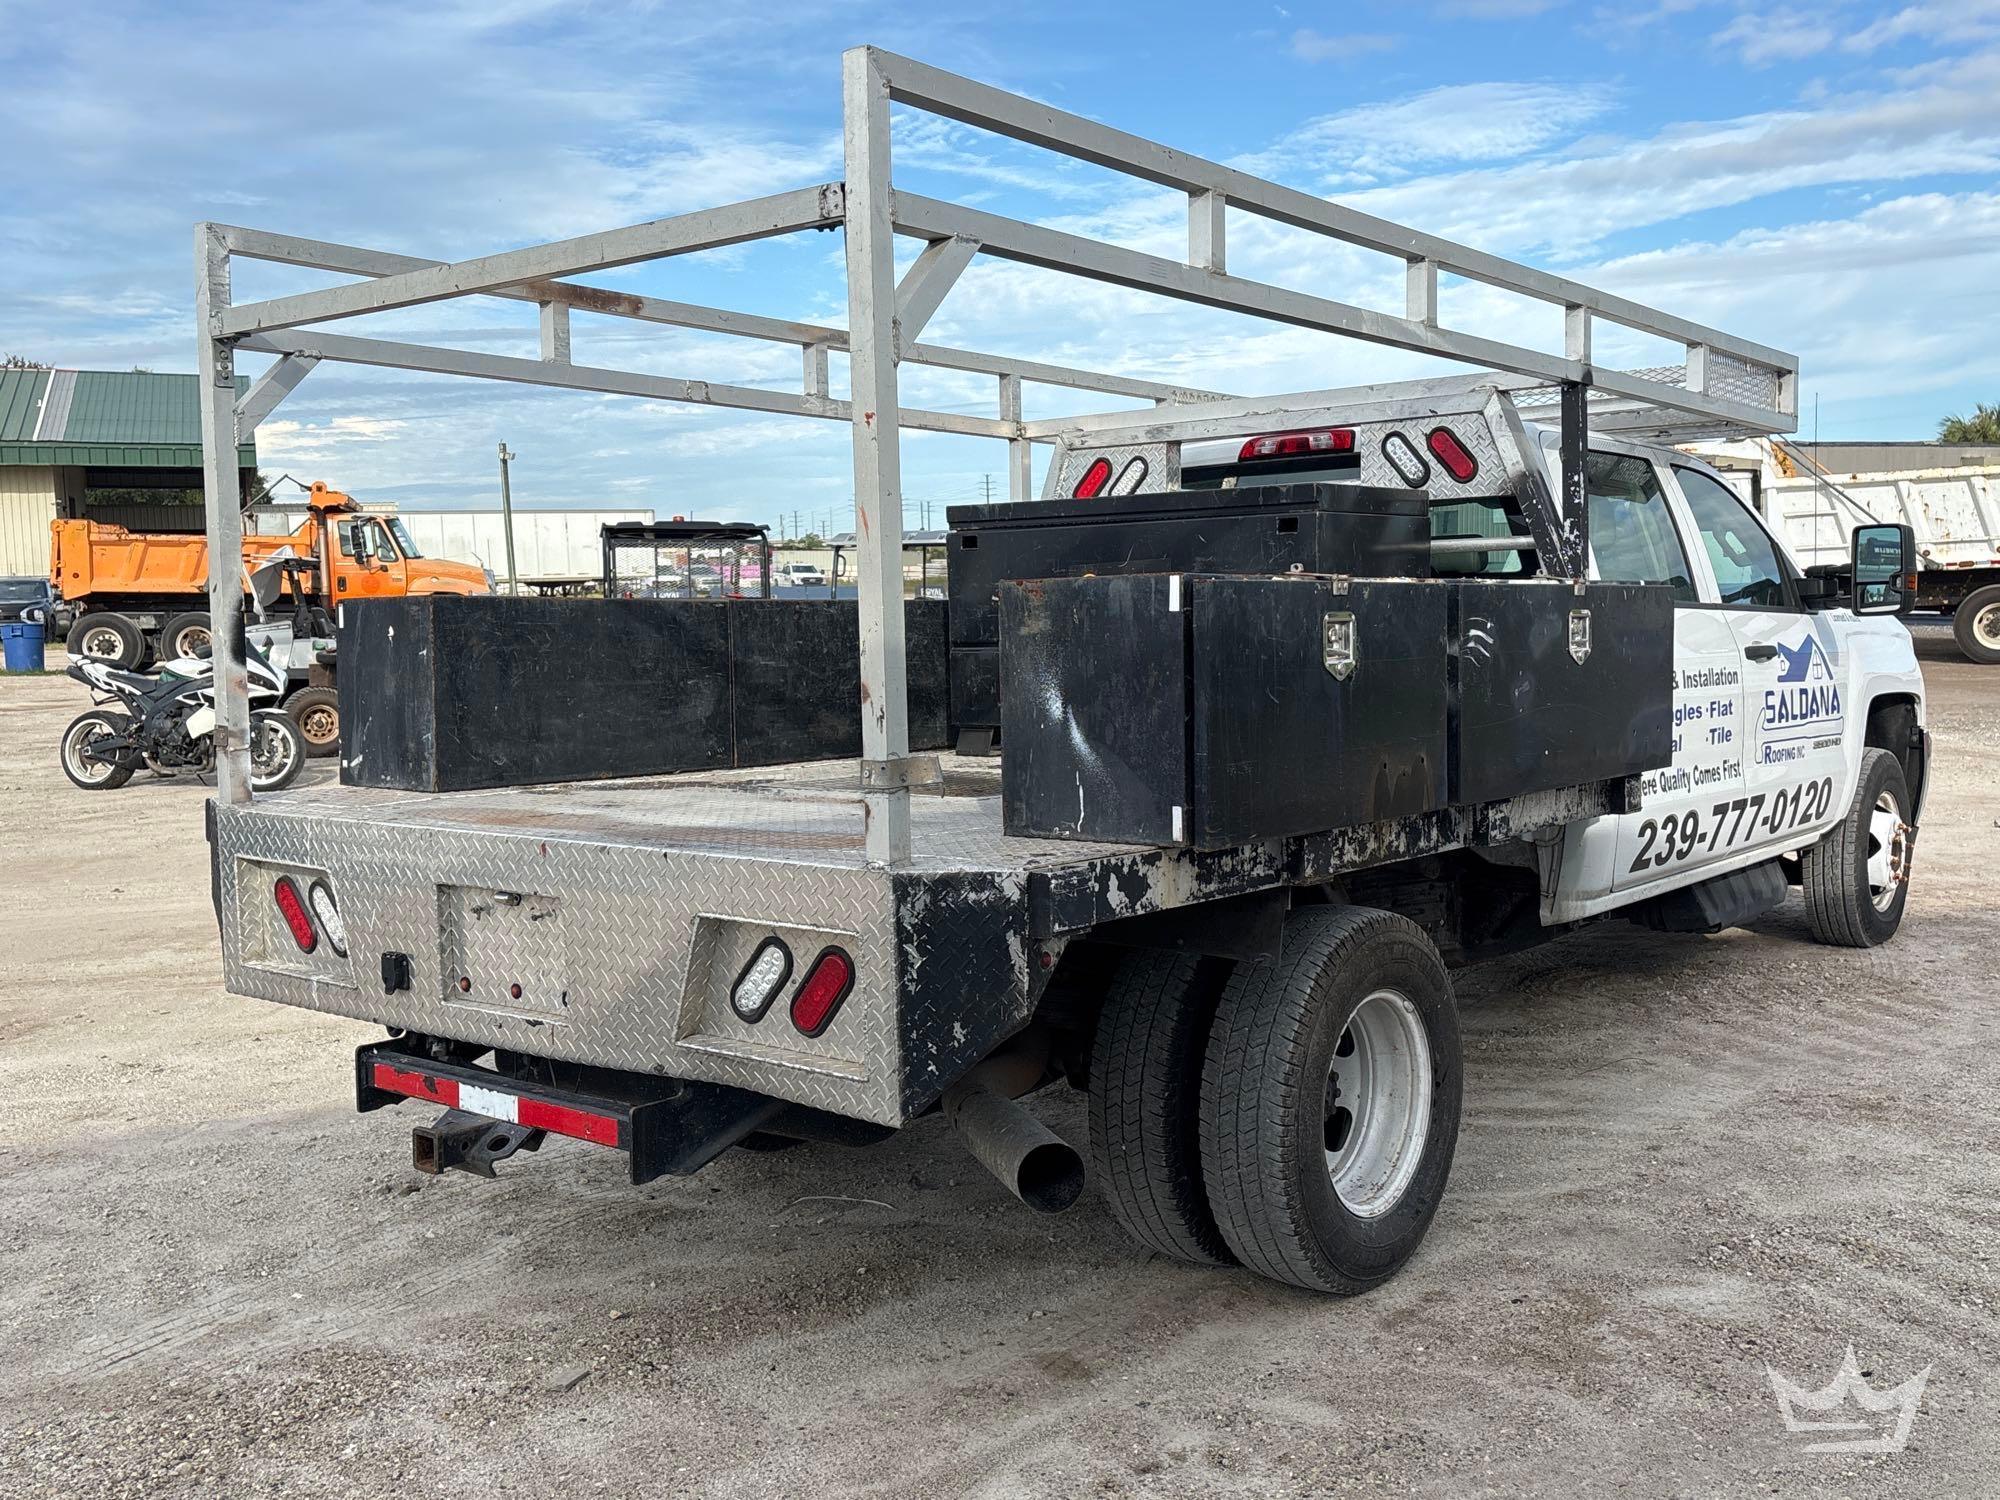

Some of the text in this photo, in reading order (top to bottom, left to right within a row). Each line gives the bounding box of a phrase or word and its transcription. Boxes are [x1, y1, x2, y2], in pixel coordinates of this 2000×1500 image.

[1682, 667, 1738, 689] Installation
[1673, 703, 1702, 727] gles
[1765, 683, 1840, 723] SALDANA
[1672, 734, 1682, 753] al
[1641, 758, 1741, 796] ere Quality Comes First
[1629, 776, 1833, 874] 239-777-0120
